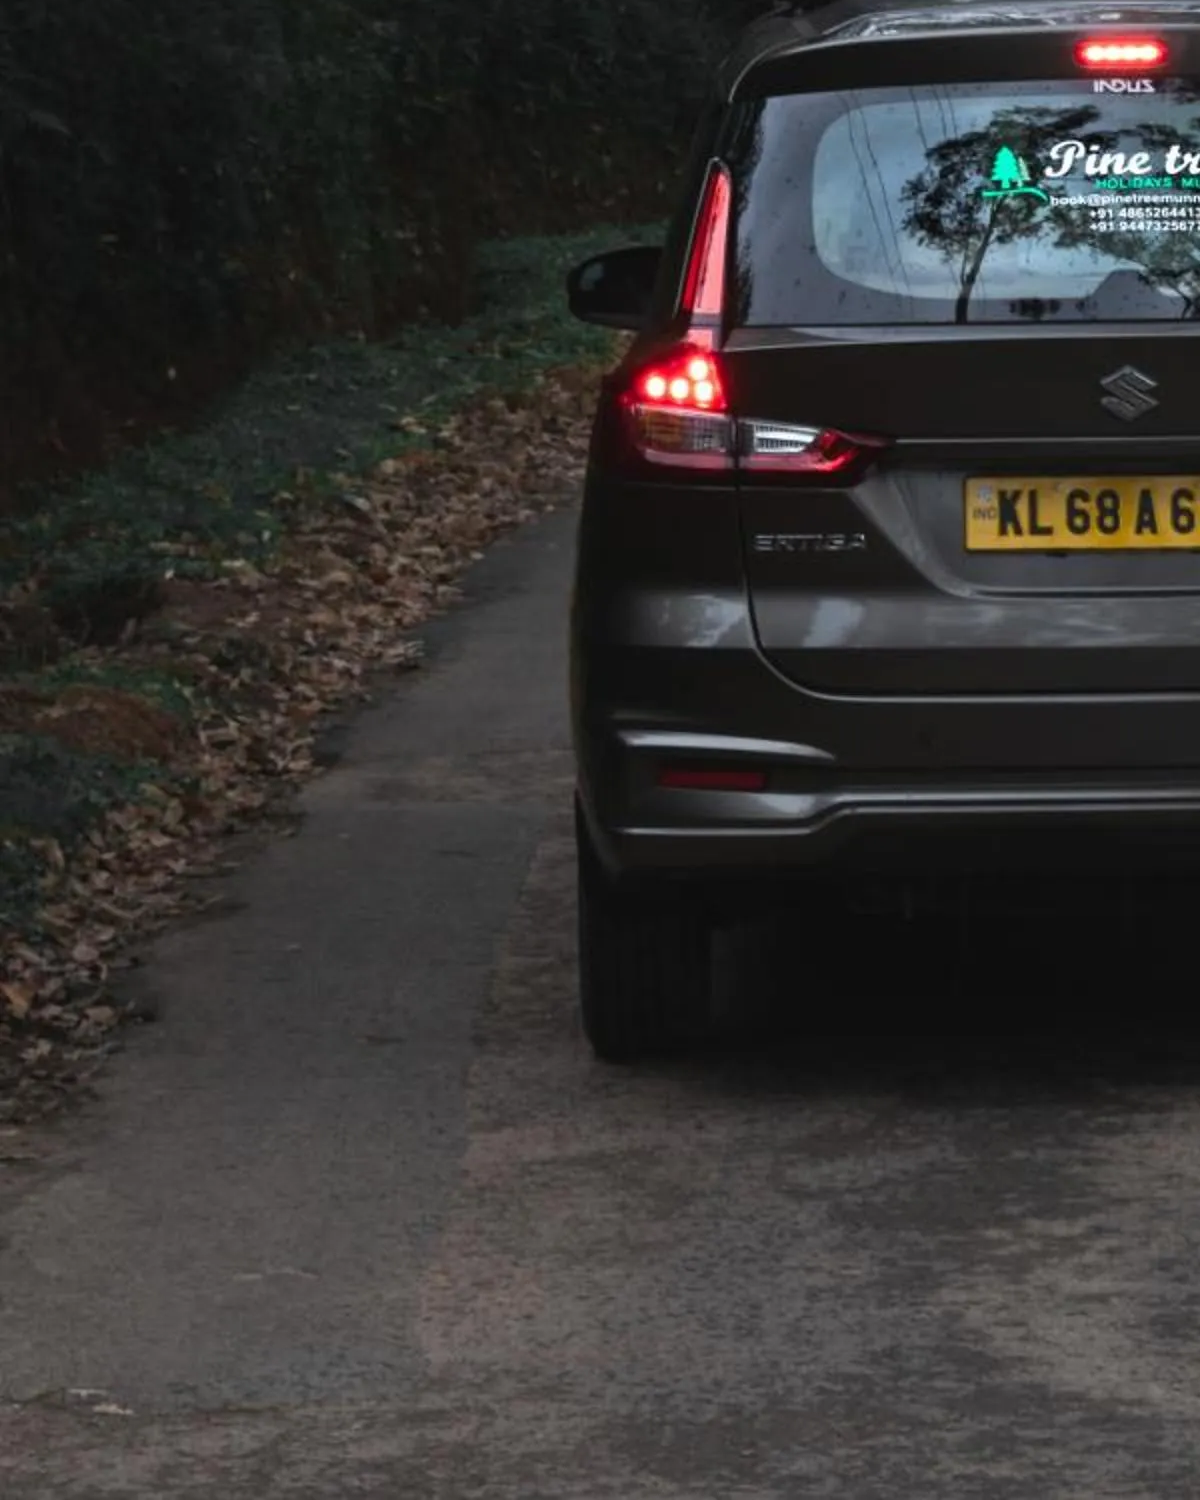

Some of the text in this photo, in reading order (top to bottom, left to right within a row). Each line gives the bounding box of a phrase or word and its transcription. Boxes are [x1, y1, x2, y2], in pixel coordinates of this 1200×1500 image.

[1045, 140, 1150, 177] Pine
[1095, 177, 1173, 189] HOLIDAYS
[1089, 207, 1113, 219] +91
[1089, 220, 1114, 232] +91
[998, 489, 1054, 537] KL
[1066, 488, 1121, 535] 68
[1135, 488, 1159, 535] A
[753, 532, 867, 552] ERTIGA
